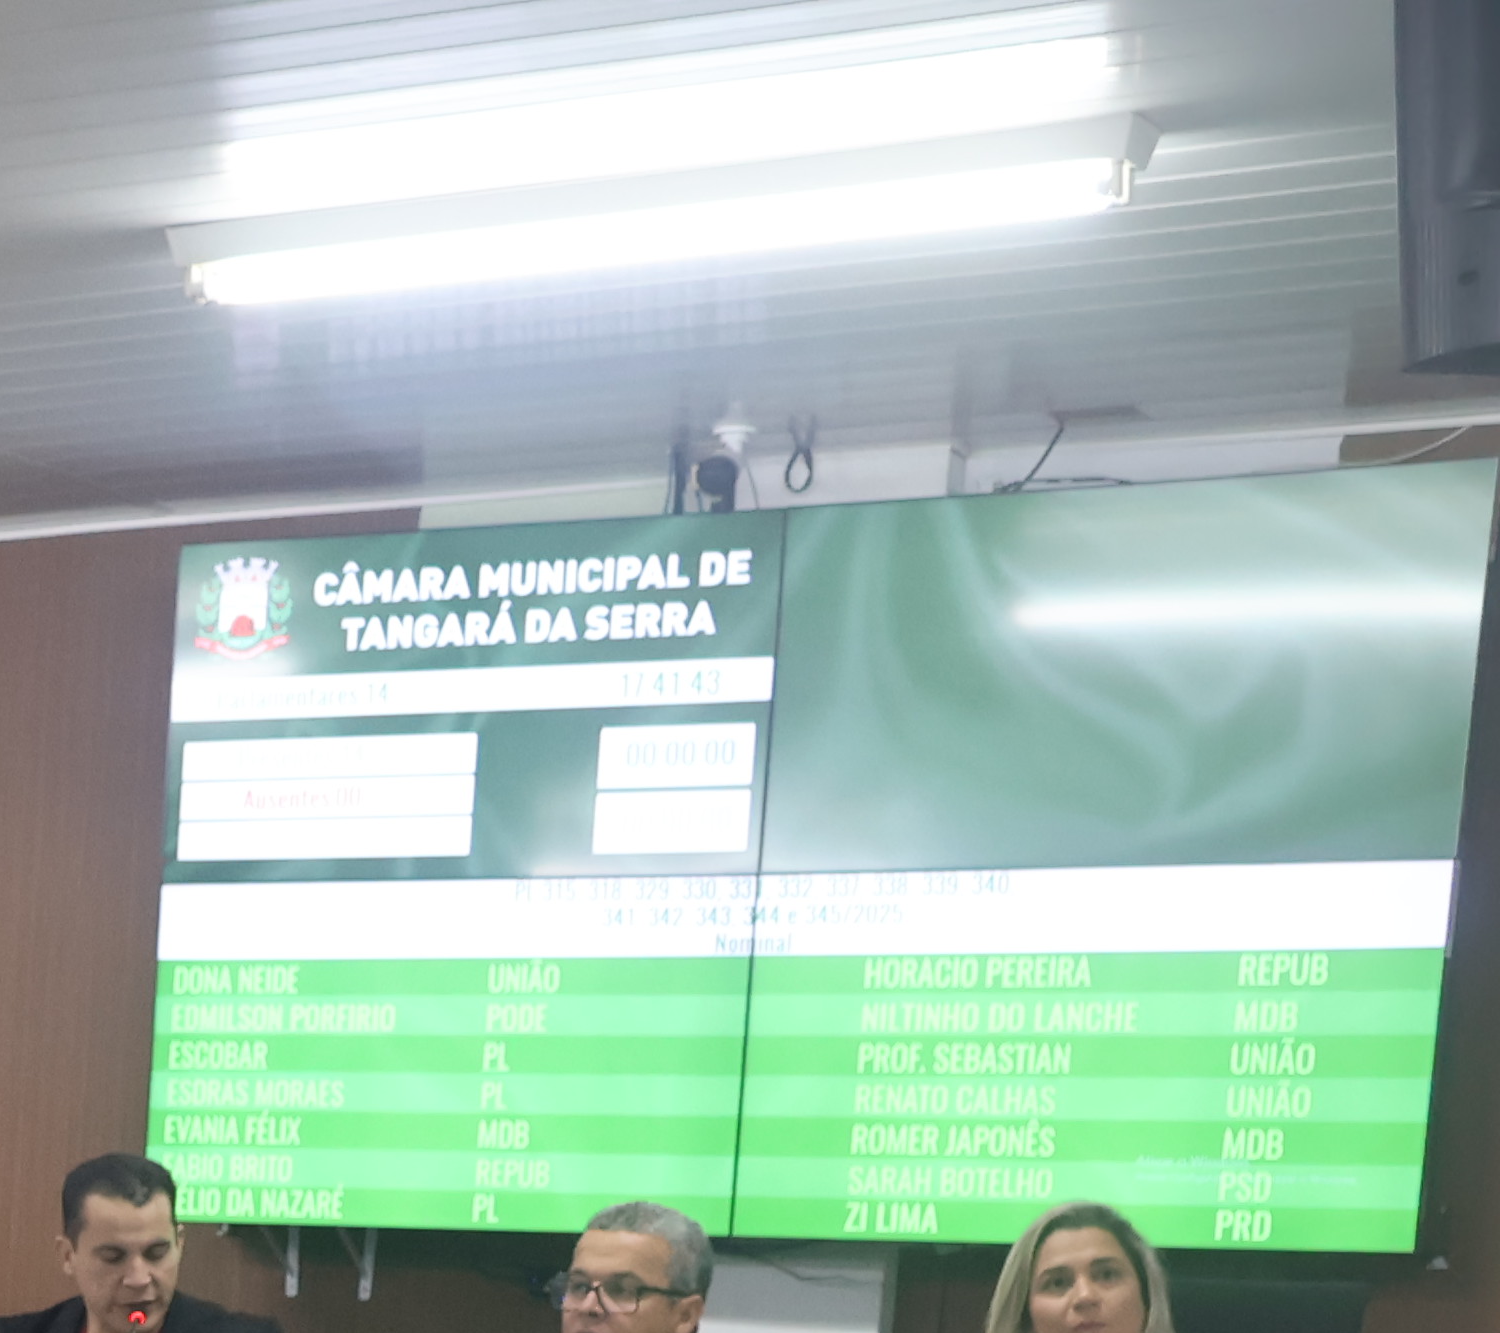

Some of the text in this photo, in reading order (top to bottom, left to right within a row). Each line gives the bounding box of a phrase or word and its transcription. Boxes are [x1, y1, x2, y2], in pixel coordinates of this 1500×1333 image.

[313, 549, 753, 607] CÂMARA MUNICIPAL DE
[341, 600, 717, 652] TANGARÁ DA SERRA
[173, 961, 561, 994] DONA NEIDE UNIÃO
[985, 956, 1091, 988] PEREIRA
[1238, 952, 1329, 987] REPUB
[171, 1004, 283, 1034] EDMILSON
[485, 1004, 548, 1033] PODE
[861, 1001, 1298, 1033] NILTINHO DO LANCHE MDB
[168, 1040, 510, 1072] ESCOBAR PL
[857, 1037, 1316, 1075] PROF. SEBASTIAN UNIÃO
[166, 1080, 507, 1109] ESDRAS MORAES PL
[855, 1080, 1311, 1118] RENATO CALHAS UNIÃO
[163, 1109, 530, 1148] EVANIA FÉLIX MDB
[850, 1119, 1284, 1161] ROMER JAPONÊS MDB
[229, 1154, 294, 1181] BRITO
[475, 1159, 550, 1188] REPUB
[847, 1167, 931, 1195] SARAH
[939, 1167, 1053, 1197] BOTELHO
[1218, 1172, 1273, 1201] PSD
[176, 1182, 498, 1223] ÉLIO DA NAZARÉ PL
[843, 1203, 1273, 1242] ZI LIMA PRD
